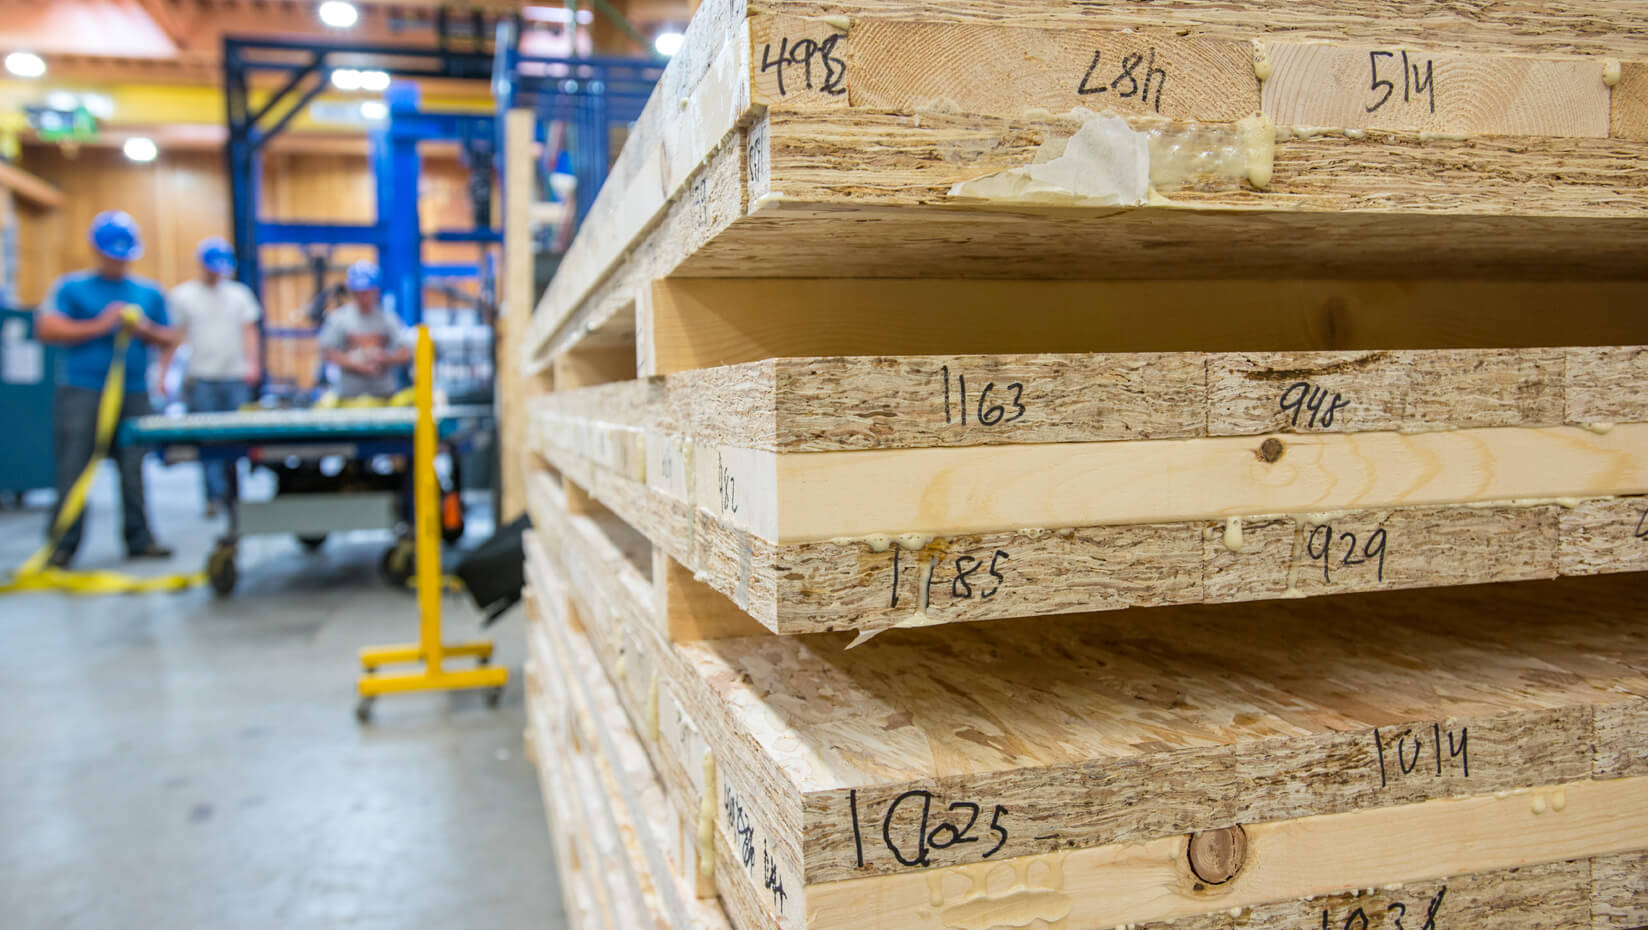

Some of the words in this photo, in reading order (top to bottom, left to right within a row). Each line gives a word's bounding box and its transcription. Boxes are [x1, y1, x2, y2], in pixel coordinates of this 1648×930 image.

[1365, 50, 1435, 113] 514
[941, 365, 1026, 426] 1163
[1280, 381, 1351, 428] 948
[891, 541, 1010, 609] 1185
[1307, 524, 1387, 584] 929
[1374, 722, 1469, 788] 1014
